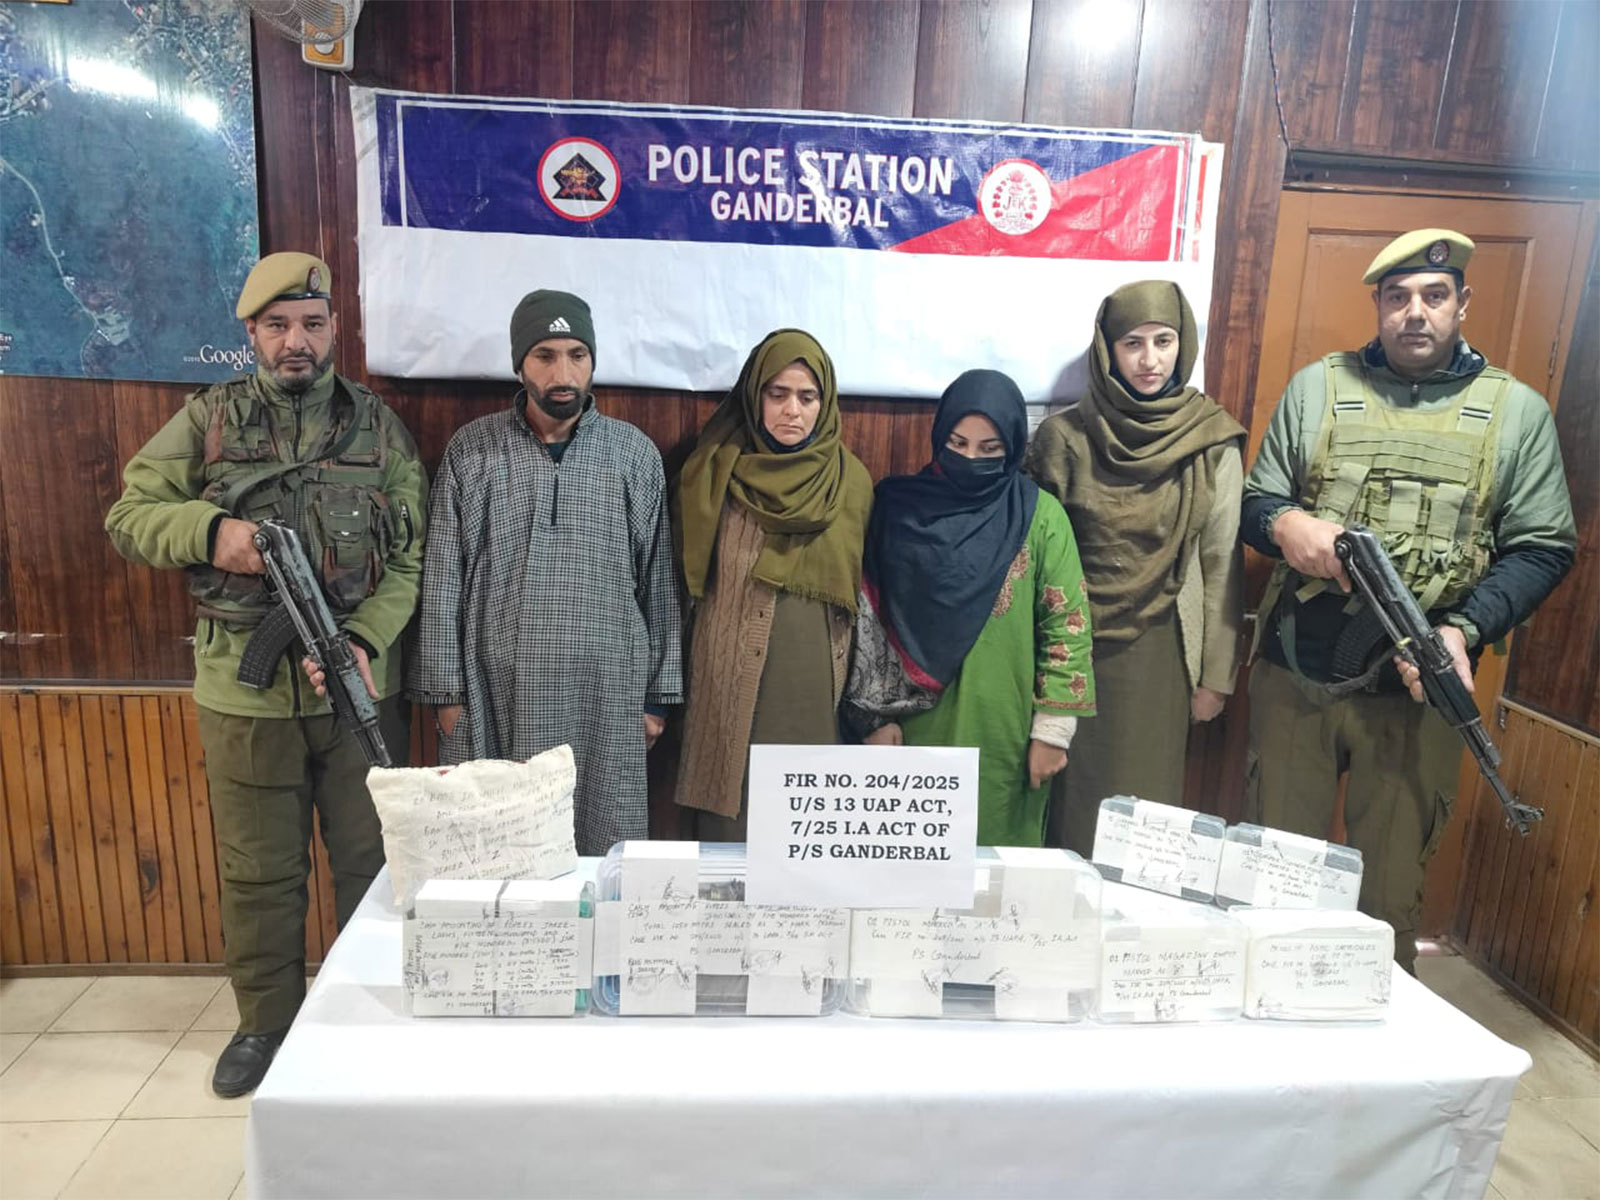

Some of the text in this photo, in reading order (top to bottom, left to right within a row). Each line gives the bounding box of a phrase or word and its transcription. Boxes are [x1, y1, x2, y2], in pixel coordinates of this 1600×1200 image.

[647, 143, 954, 195] POLICE STATION
[711, 190, 889, 228] GANDERBAL
[200, 344, 255, 371] Google
[783, 773, 960, 791] FIR NO. 204/2025
[789, 797, 952, 816] U/S 13 UAP ACT,
[791, 820, 950, 837] 7/25 I.A ACT OF
[788, 844, 951, 860] P/S GANDERBAL
